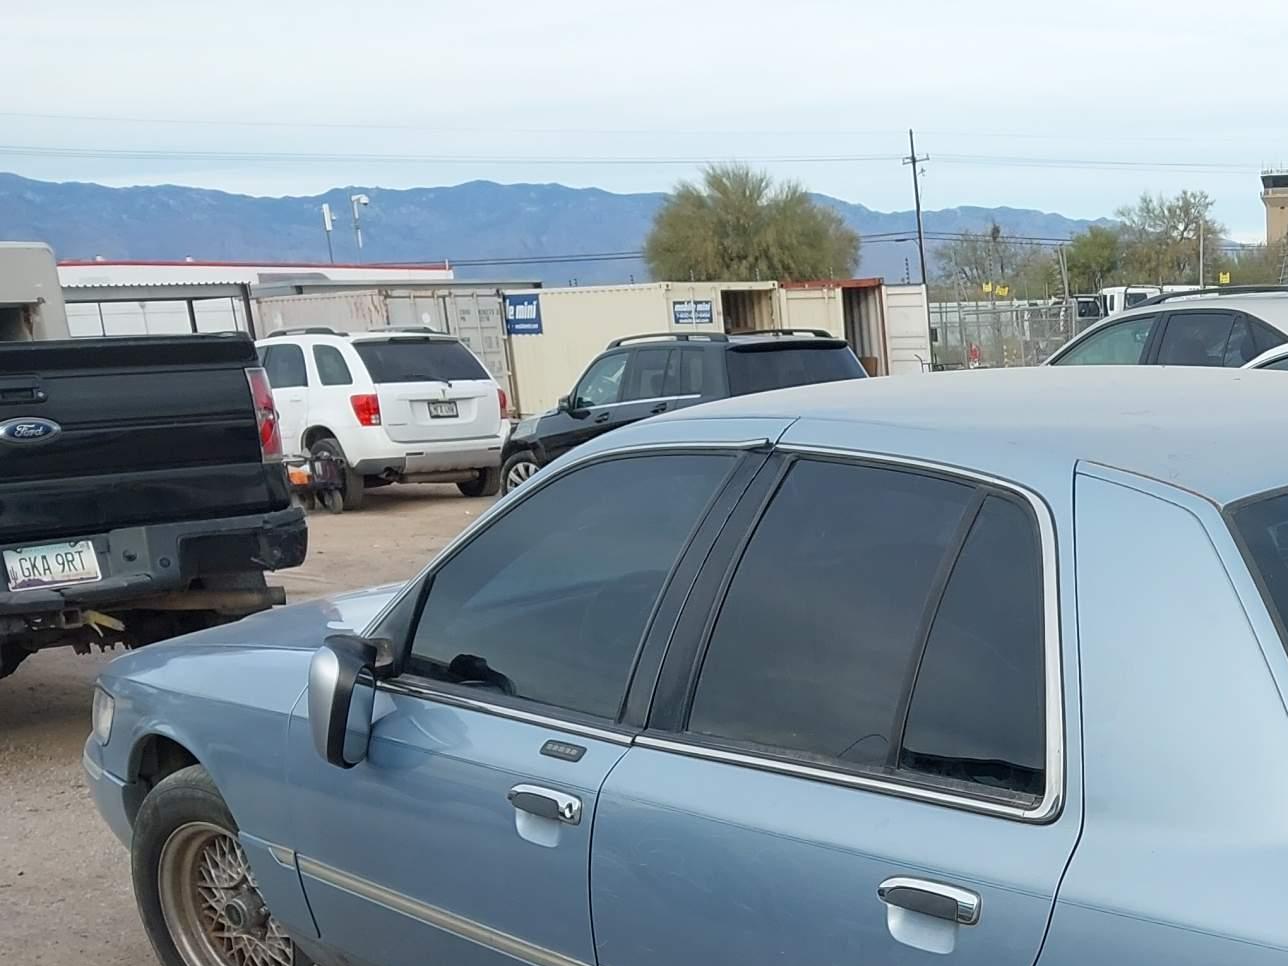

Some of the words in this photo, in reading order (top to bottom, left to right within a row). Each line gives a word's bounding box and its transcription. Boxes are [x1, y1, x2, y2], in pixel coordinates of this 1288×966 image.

[515, 300, 538, 319] mini
[14, 424, 44, 437] Ford
[18, 555, 52, 578] GKA
[55, 550, 86, 573] 9RT
